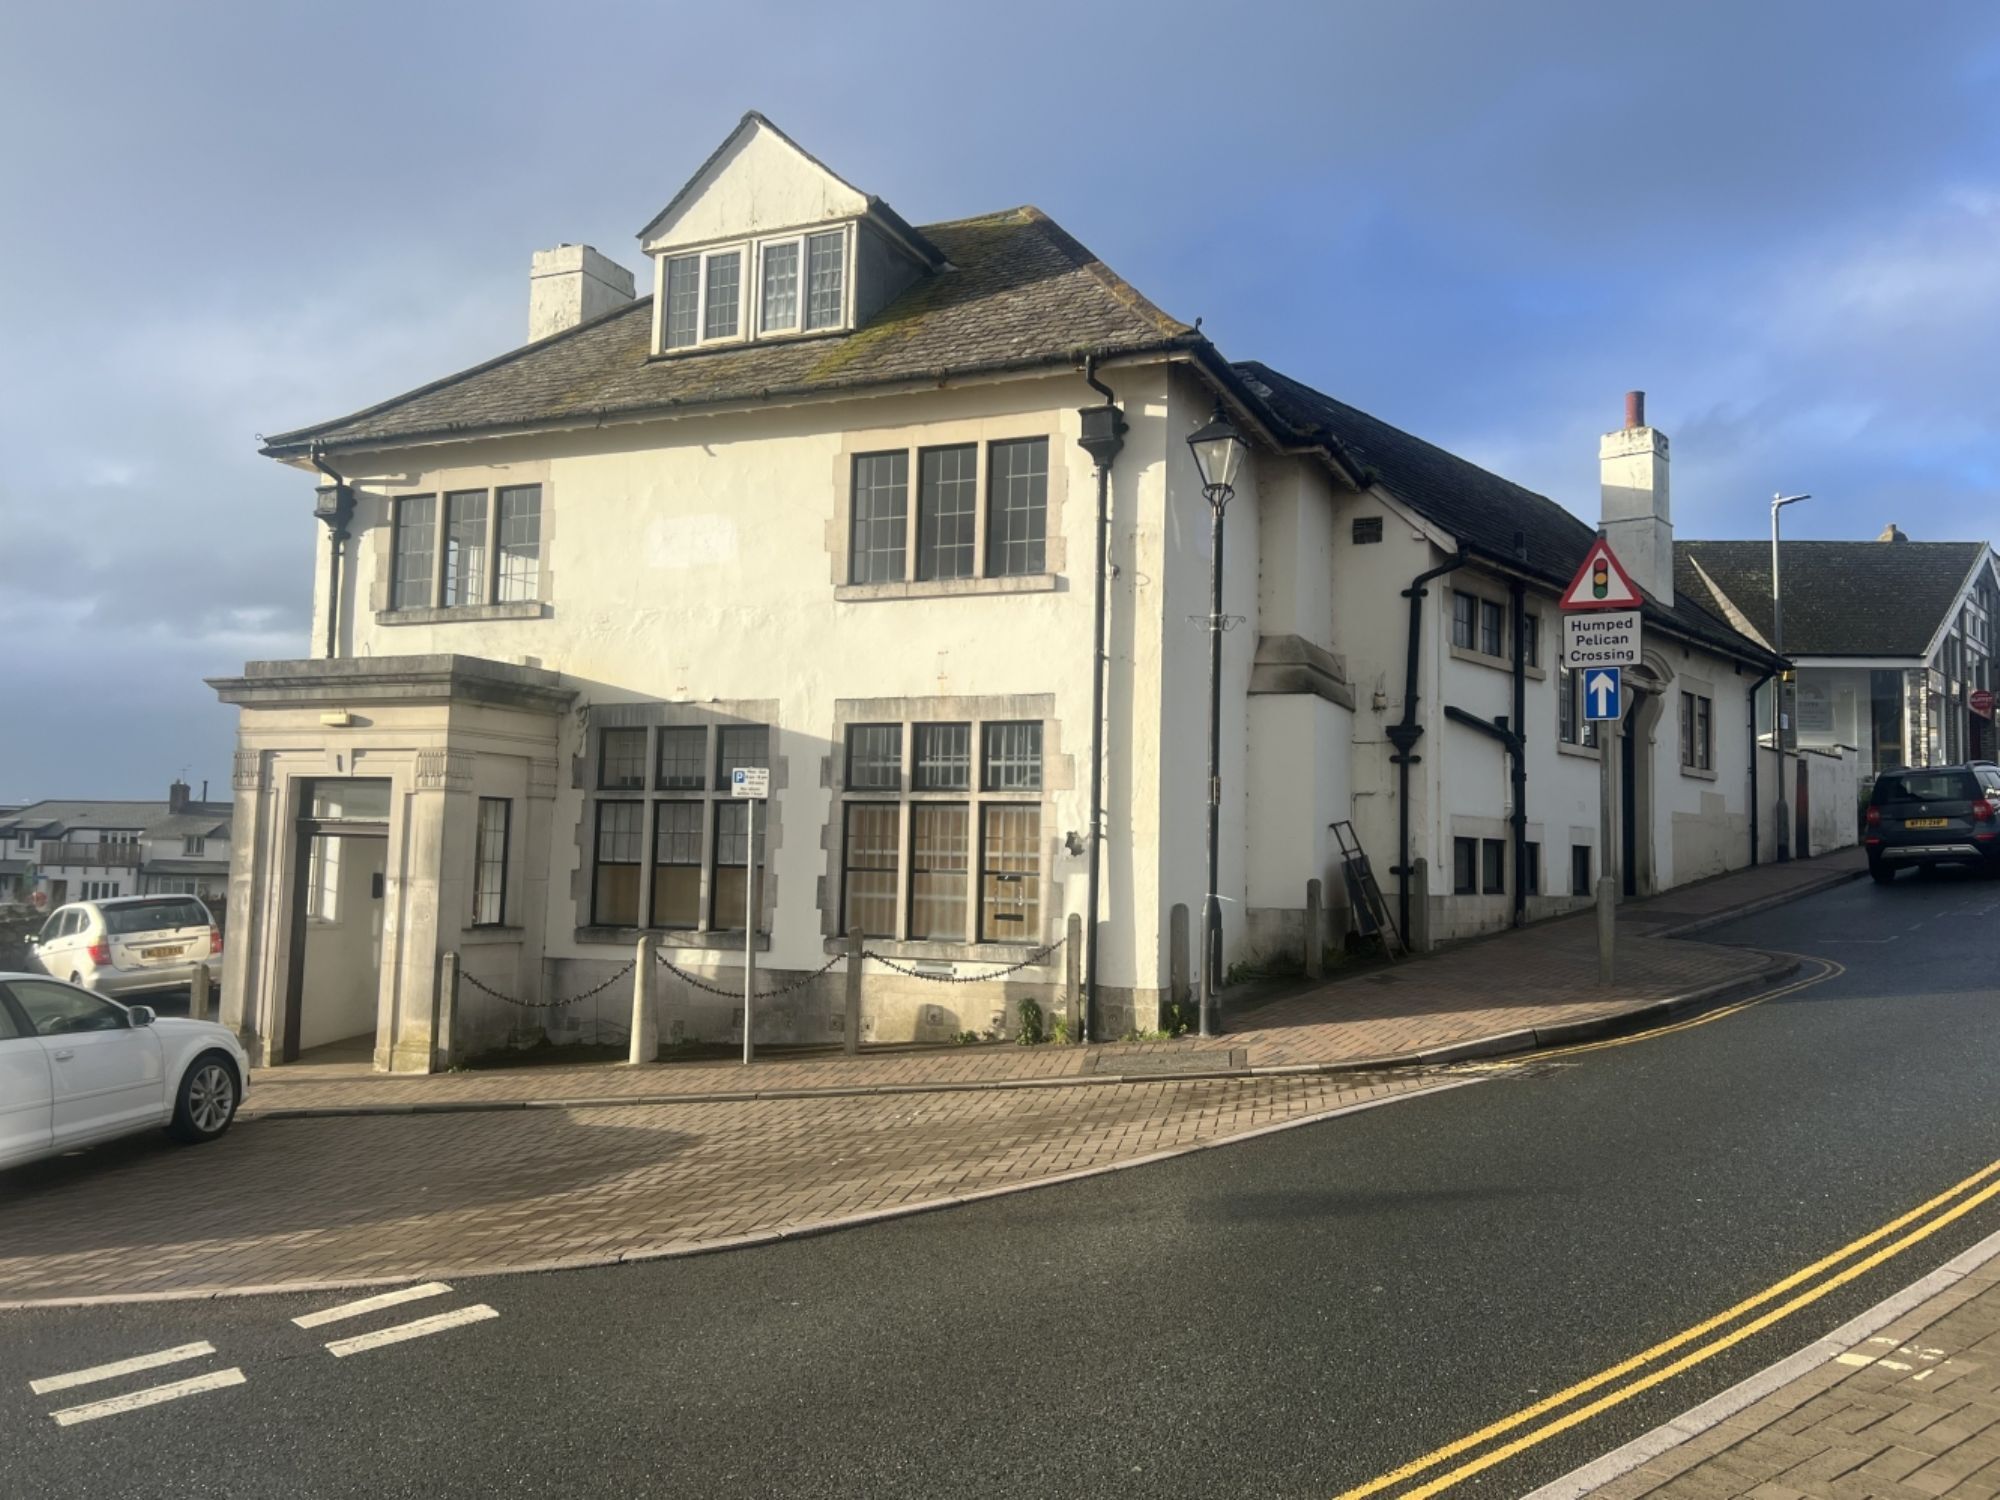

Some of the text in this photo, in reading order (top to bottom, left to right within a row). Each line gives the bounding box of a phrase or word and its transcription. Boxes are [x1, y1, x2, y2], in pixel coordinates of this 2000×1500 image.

[1571, 617, 1633, 632] Humped
[1576, 633, 1629, 647] Pelican
[1570, 648, 1634, 662] Crossing
